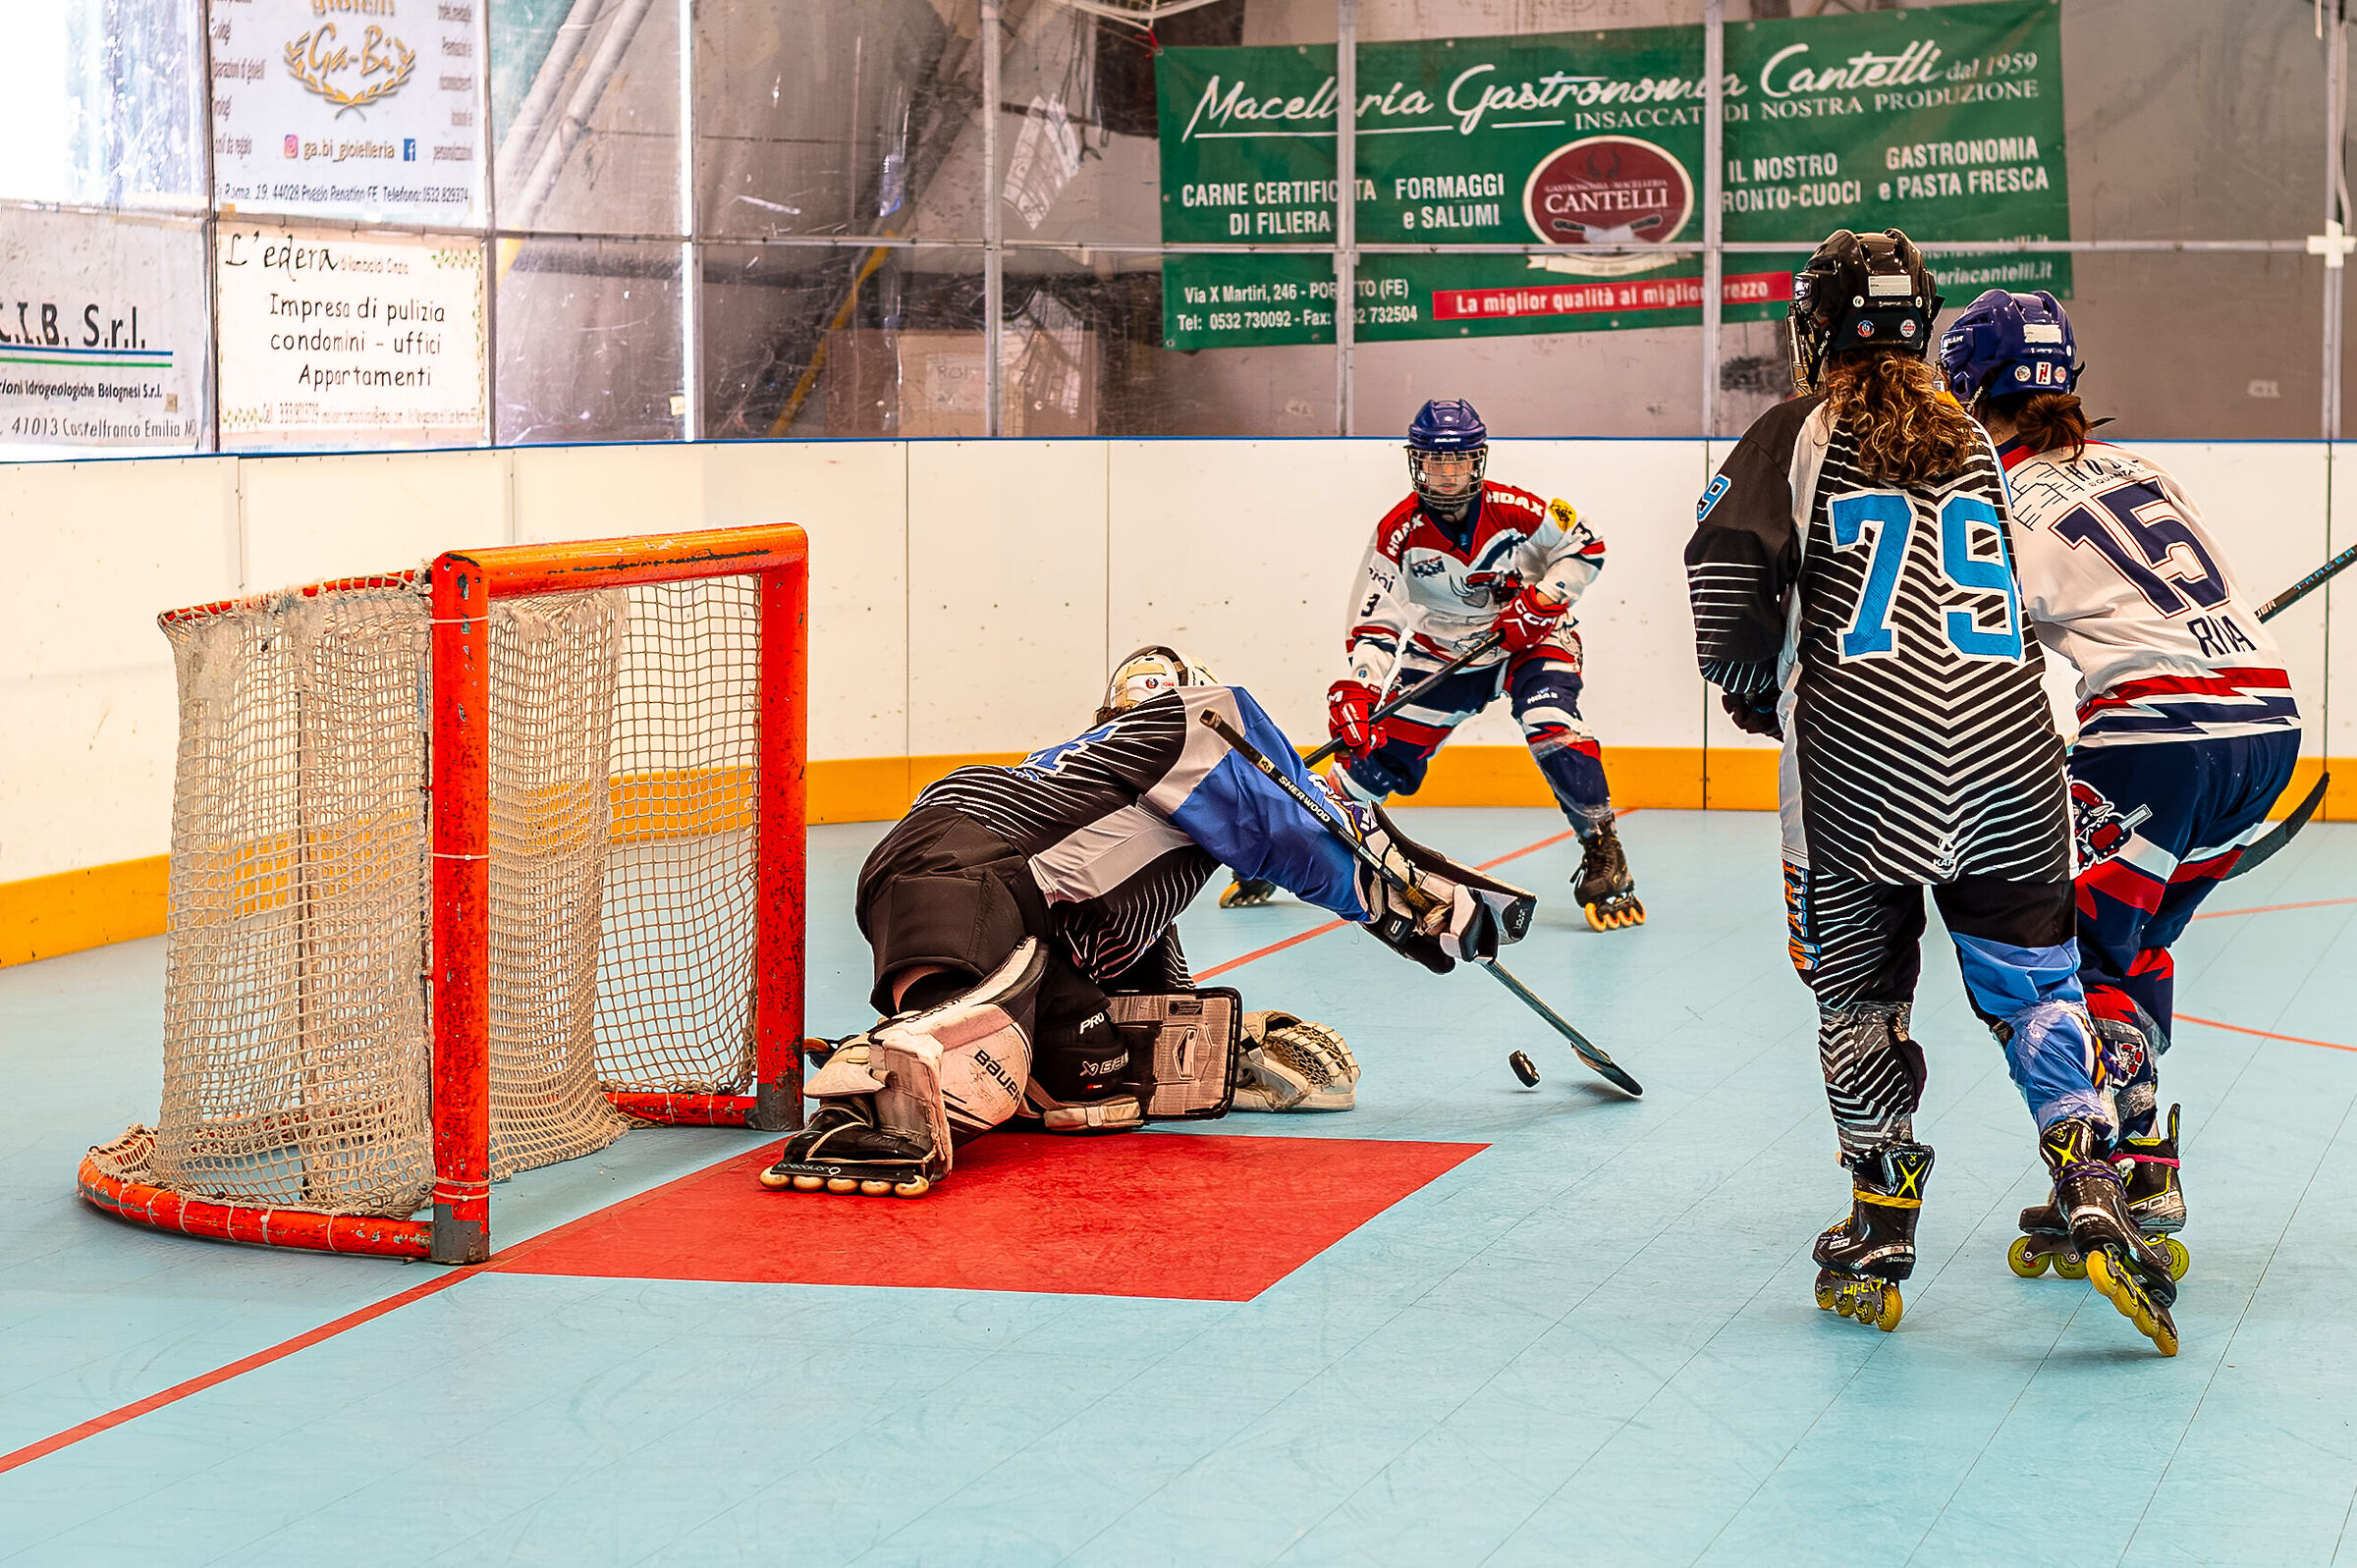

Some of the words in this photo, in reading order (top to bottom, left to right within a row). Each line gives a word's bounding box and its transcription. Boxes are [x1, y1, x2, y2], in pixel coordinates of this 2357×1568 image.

[309, 22, 394, 78] Ga-Bi
[1181, 75, 1435, 142] Macellria
[1761, 40, 1944, 98] Cantelli
[1946, 58, 1979, 82] dal
[1985, 51, 2039, 77] 1959
[1574, 105, 1706, 131] INSACCAT
[1725, 102, 1749, 123] DI
[1761, 95, 1864, 123] NOSTRA
[1874, 79, 2040, 113] PRODUZIONE
[303, 138, 395, 163] ga.bi_gioielleria
[1886, 136, 2040, 170] GASTRONOMIA
[1728, 159, 1748, 184] IL
[1754, 152, 1838, 183] NOSTRO
[1182, 183, 1249, 207] CARNE
[1254, 180, 1377, 204] CERTIFICTA
[1396, 173, 1505, 200] FORMAGGI
[1722, 180, 1861, 213] RONTO-CUOCI
[1879, 181, 1891, 200] e
[1897, 173, 1962, 199] PASTA
[1968, 166, 2051, 194] FRESCA
[1545, 187, 1669, 214] CANTELLI
[1230, 213, 1250, 236] DI
[1257, 210, 1332, 235] FILIERA
[1402, 211, 1415, 230] e
[1421, 203, 1501, 229] SALUMI
[1184, 286, 1206, 303] Via
[1209, 286, 1220, 302] X
[1223, 285, 1271, 303] Martiri,
[1274, 283, 1297, 300] 246
[1380, 279, 1409, 300] (FE)
[1456, 295, 1478, 313] La
[1484, 293, 1548, 315] miglior
[1553, 287, 1615, 312] qualità
[1619, 287, 1638, 305] al
[1723, 281, 1768, 298] rezzo
[270, 293, 350, 323] Impresa
[356, 297, 378, 319] di
[387, 298, 446, 326] pulizia
[1178, 314, 1203, 331] Tel:
[1210, 312, 1241, 330] 0532
[1244, 311, 1291, 328] 730092
[1303, 309, 1332, 326] Fax:
[1369, 305, 1417, 325] 732504
[83, 303, 146, 349] S.r.l.
[270, 328, 365, 351] condomini
[394, 332, 441, 354] uffici
[25, 380, 95, 401] Idrogeologiche
[98, 382, 140, 403] Bolognesi
[142, 383, 162, 399] S.r.l.
[298, 364, 431, 392] Appartamenti
[12, 416, 58, 436] 41013
[63, 417, 140, 438] Castelfranco
[144, 419, 180, 438] Emilia
[2048, 475, 2230, 620] 15
[1826, 488, 2026, 666] 79
[1079, 1012, 1105, 1035] PRO
